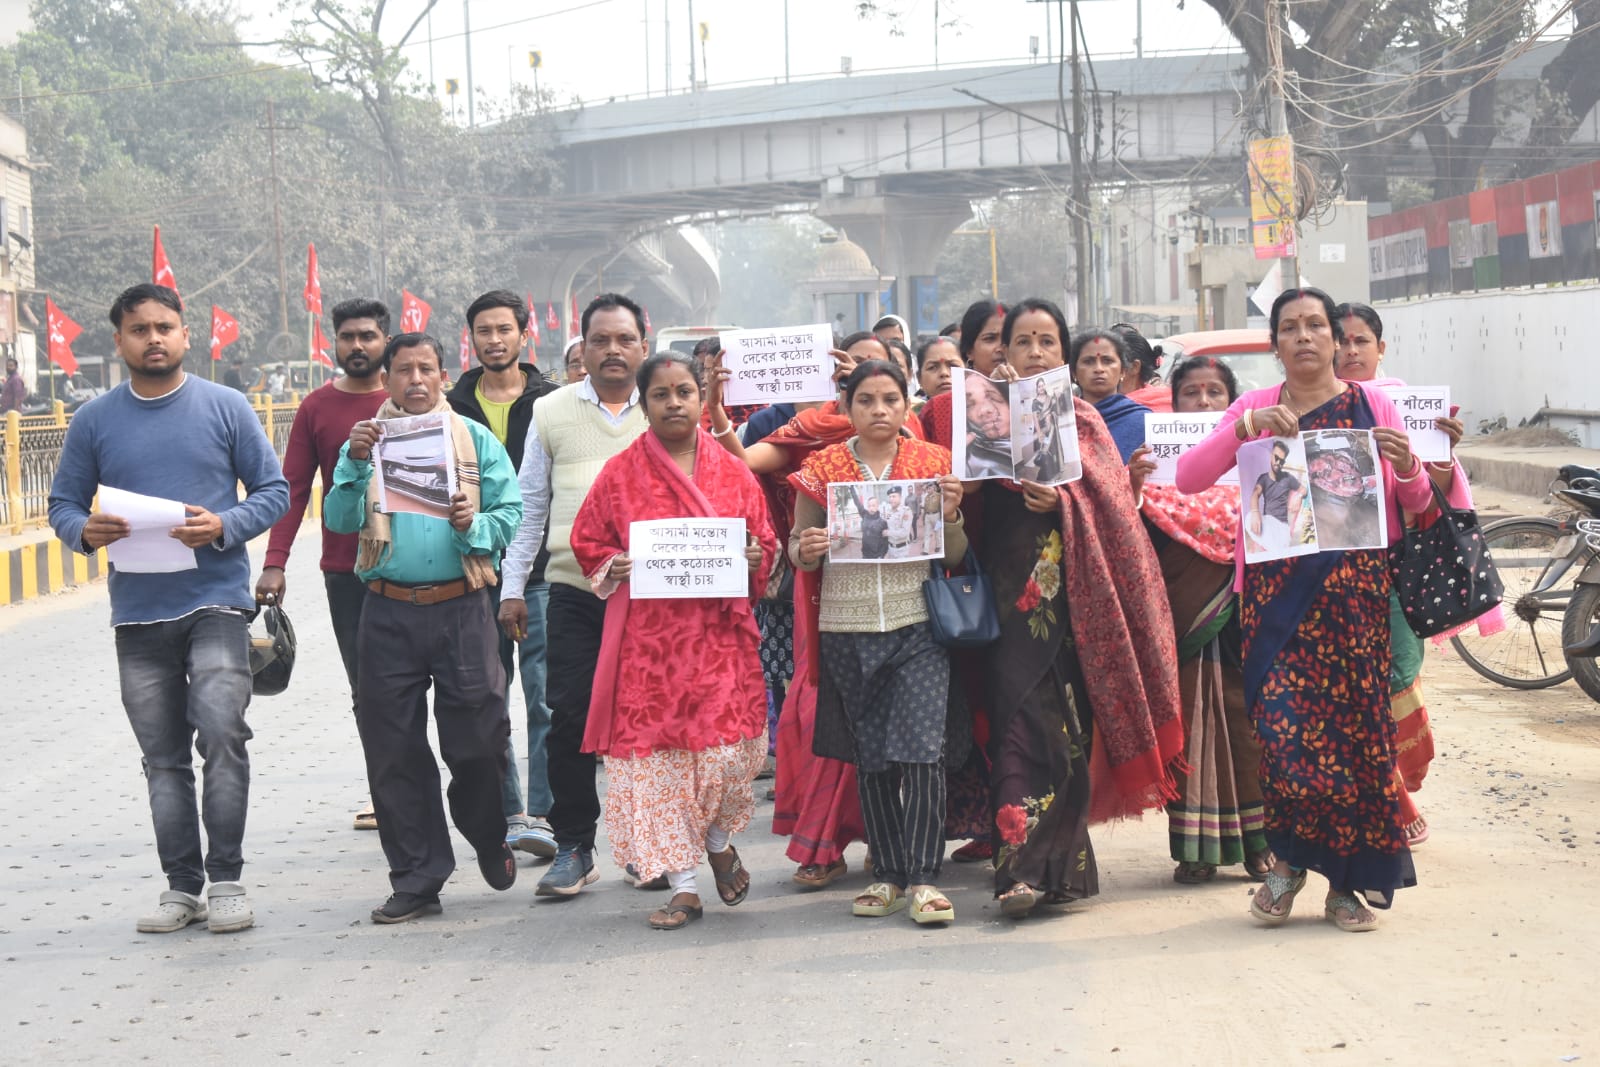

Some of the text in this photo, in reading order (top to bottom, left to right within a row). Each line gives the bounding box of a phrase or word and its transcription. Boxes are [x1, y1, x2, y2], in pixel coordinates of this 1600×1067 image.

[742, 346, 813, 364] দেবের কঠোর
[739, 363, 820, 380] থেকে কঠোরতম
[784, 381, 803, 391] চায়
[1402, 395, 1444, 410] শীলের
[1151, 420, 1206, 434] মোমিতা
[651, 540, 726, 553] দেবের কঠোর
[646, 555, 733, 569] থেকে কঠোরতম
[694, 575, 715, 586] চায়
